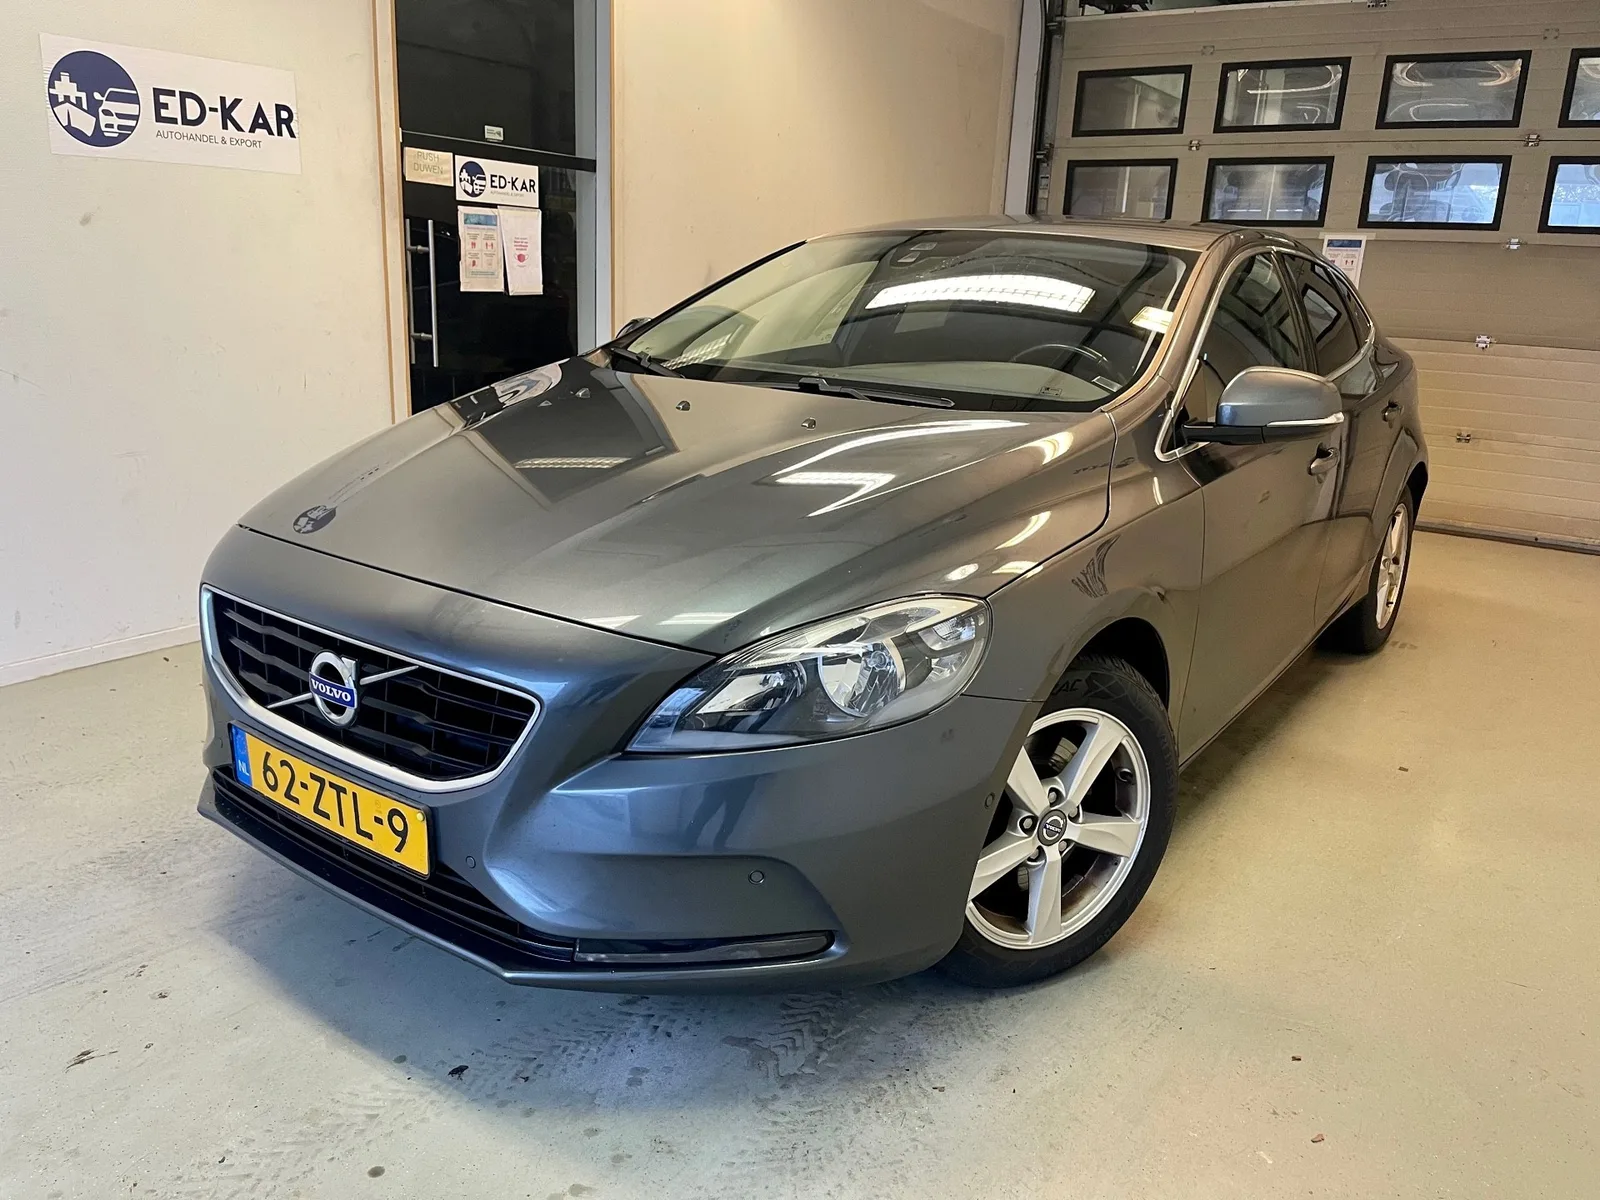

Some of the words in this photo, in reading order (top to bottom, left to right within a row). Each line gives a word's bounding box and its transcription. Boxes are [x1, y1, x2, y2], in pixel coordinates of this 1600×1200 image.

[152, 86, 297, 139] ED-KAR
[155, 130, 219, 145] AUTOHANDEL
[221, 135, 228, 145] &
[230, 136, 262, 149] EXPORT
[416, 150, 440, 162] PUSH
[413, 162, 444, 175] DUWEN
[490, 174, 536, 193] ED-KAR
[311, 678, 351, 702] VOLVO
[238, 759, 250, 776] NL
[262, 751, 409, 853] 62-ZTL-9
